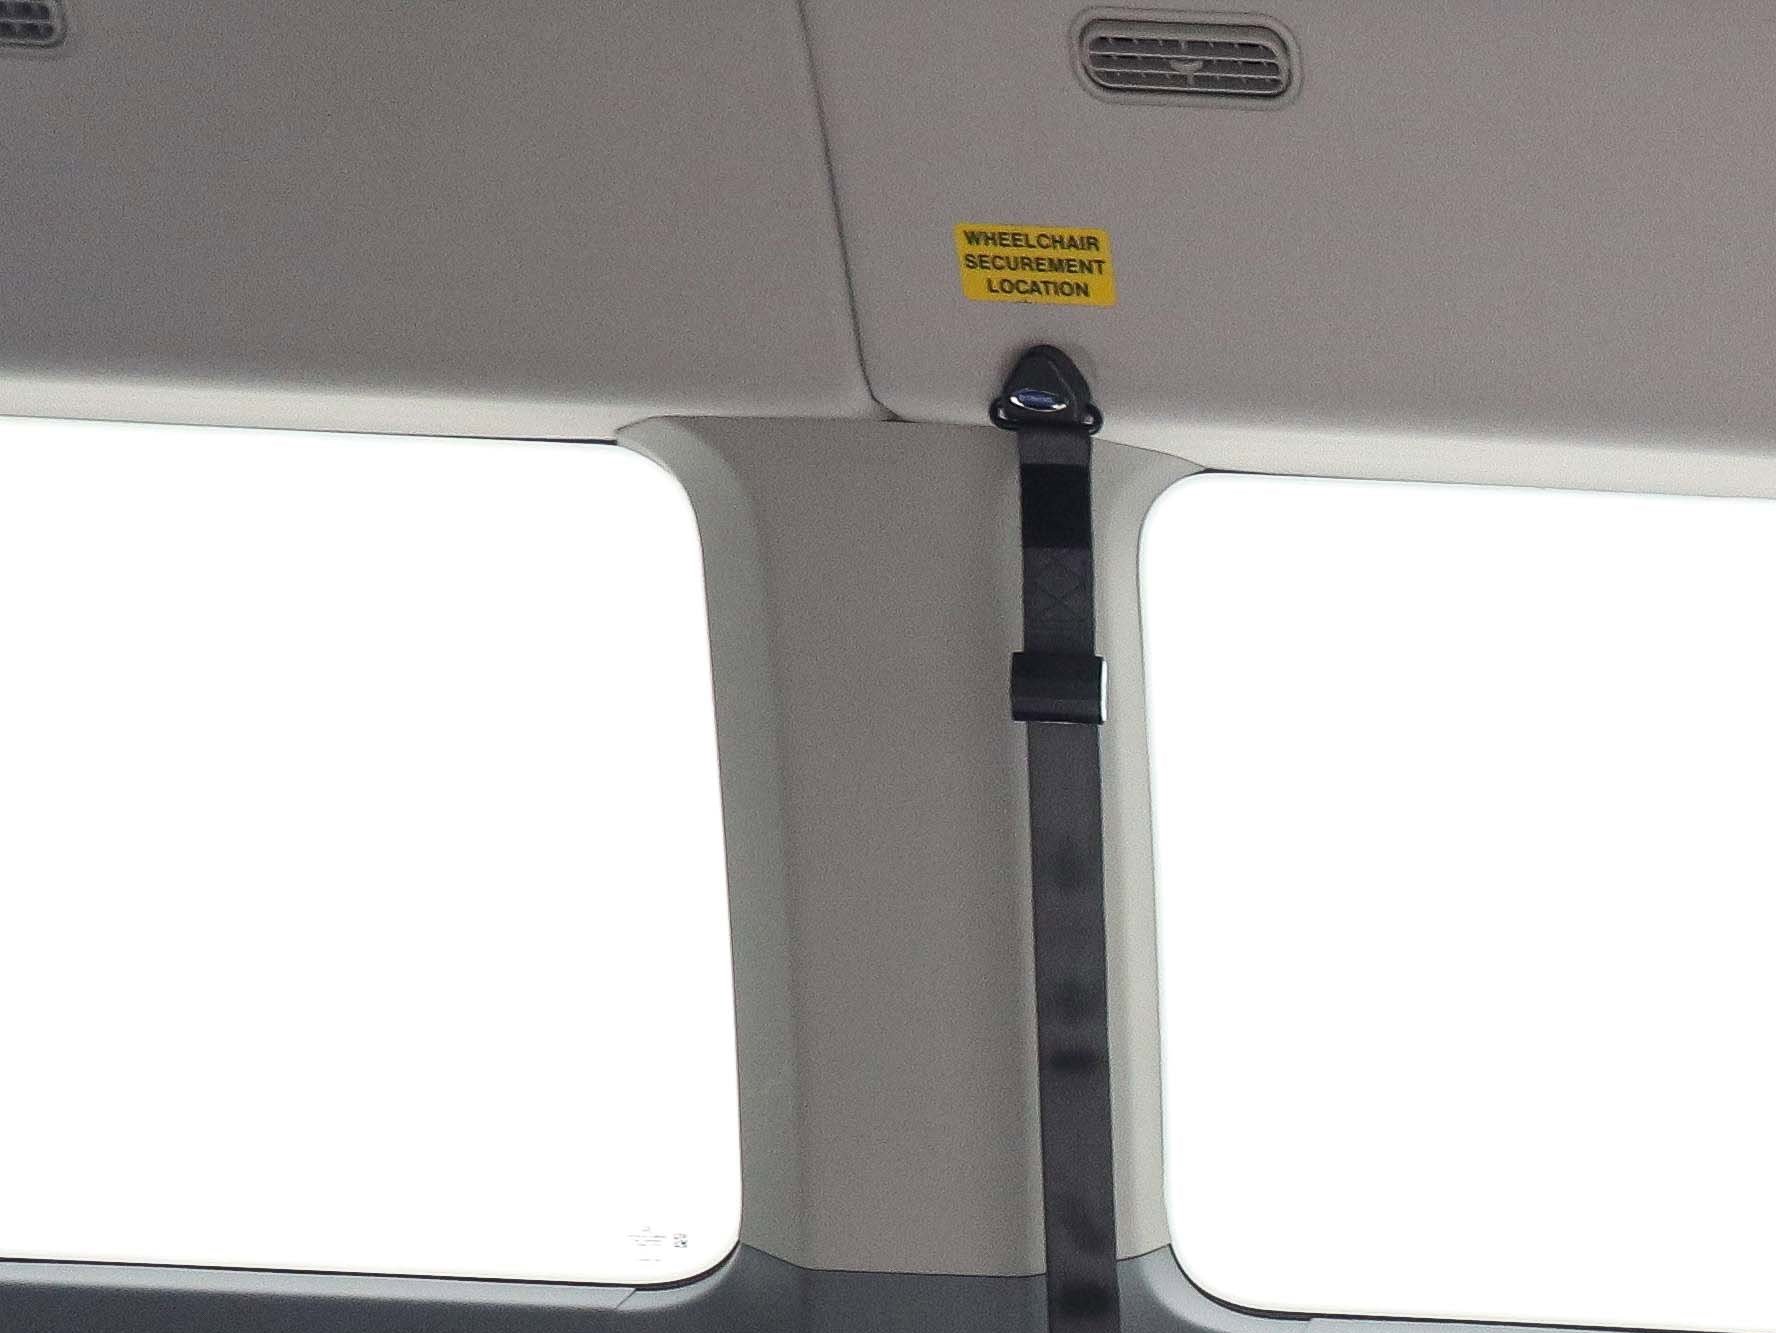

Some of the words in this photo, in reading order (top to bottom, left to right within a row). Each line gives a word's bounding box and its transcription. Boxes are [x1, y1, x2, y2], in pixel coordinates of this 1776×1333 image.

[963, 230, 1100, 251] WHEELCHAIR
[965, 254, 1106, 275] SECUREMENT
[985, 278, 1090, 298] LOCATION
